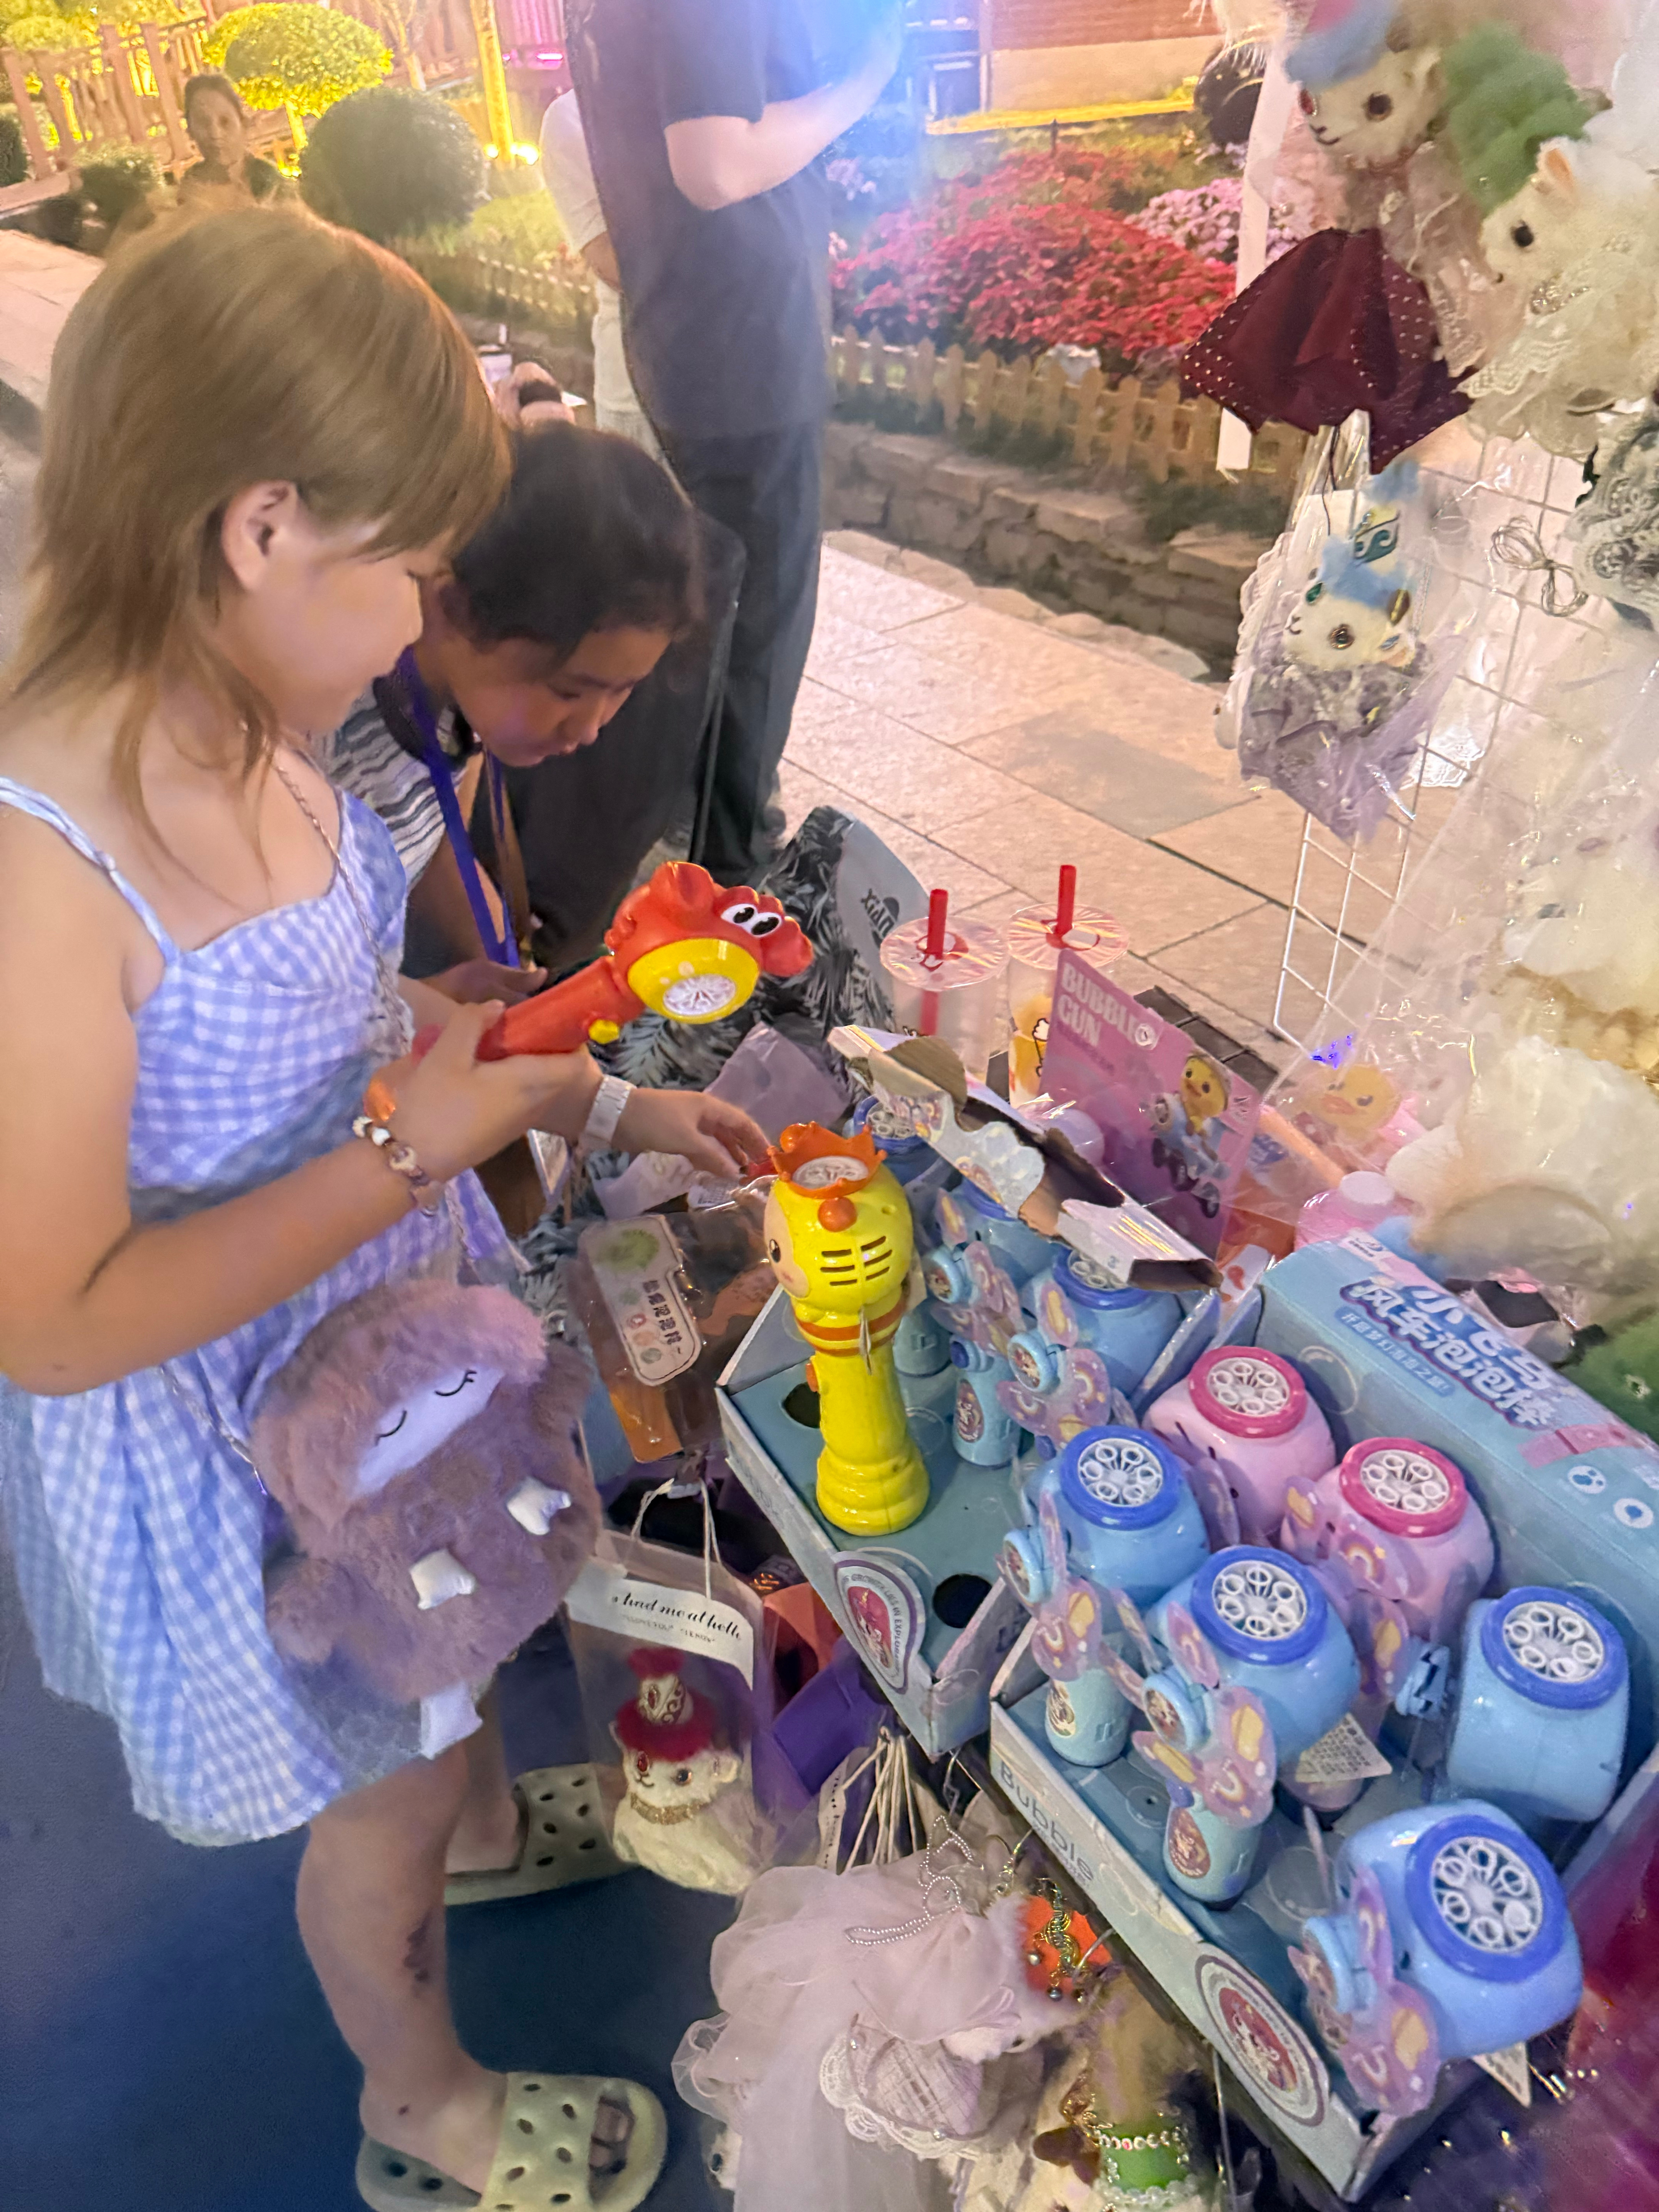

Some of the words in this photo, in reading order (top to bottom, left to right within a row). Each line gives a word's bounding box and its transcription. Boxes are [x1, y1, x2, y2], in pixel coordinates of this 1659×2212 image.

[1058, 994, 1102, 1046] GUN
[1349, 1285, 1553, 1425] 风车泡泡棒
[1410, 1290, 1549, 1389] 小飞马
[893, 1607, 901, 1616] IN
[1001, 1760, 1094, 1881] Bubble
